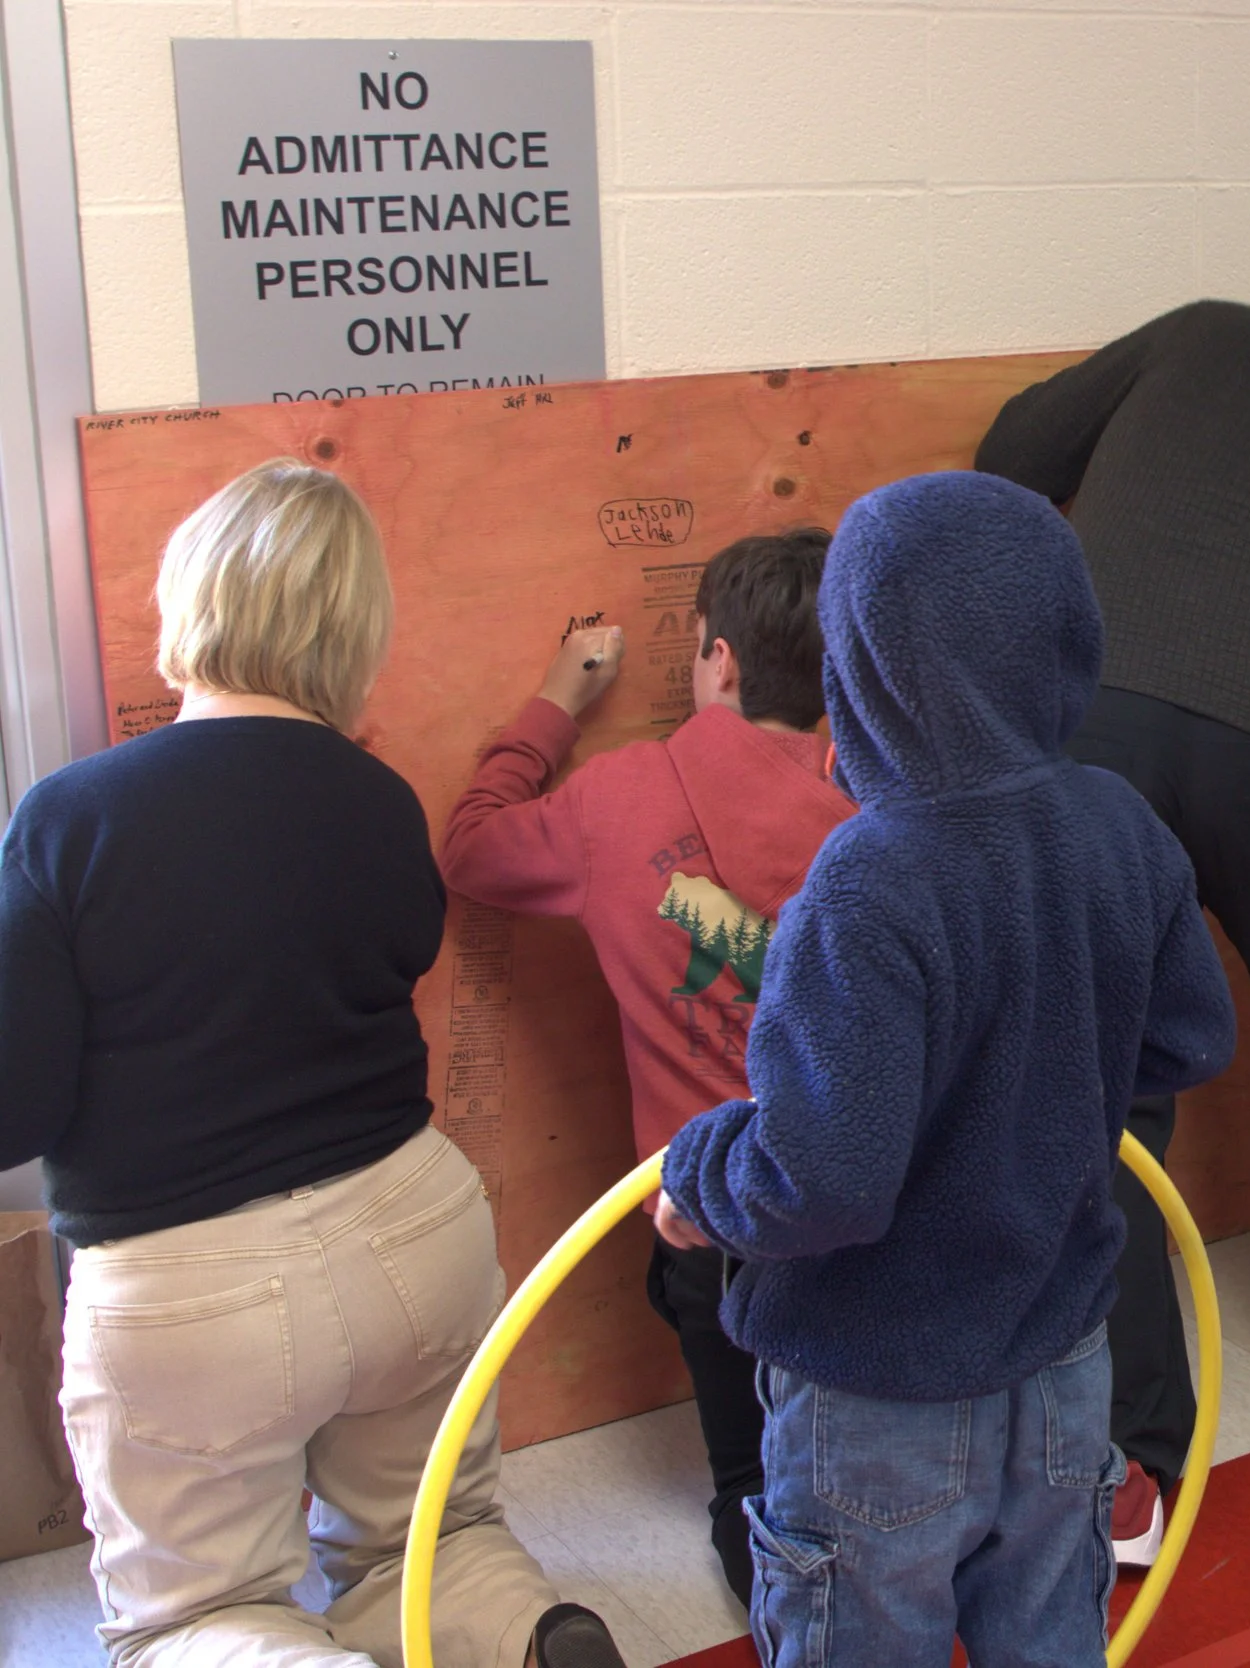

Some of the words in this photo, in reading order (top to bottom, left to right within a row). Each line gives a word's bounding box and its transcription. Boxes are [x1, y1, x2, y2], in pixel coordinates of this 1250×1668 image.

[360, 71, 428, 110] NO
[238, 131, 549, 175] ADMITTANCE
[221, 190, 571, 239] MAINTENANCE
[256, 251, 548, 300] PERSONNEL
[347, 313, 470, 355] ONLY
[604, 501, 686, 524] Jackson
[37, 1508, 70, 1535] PB2
